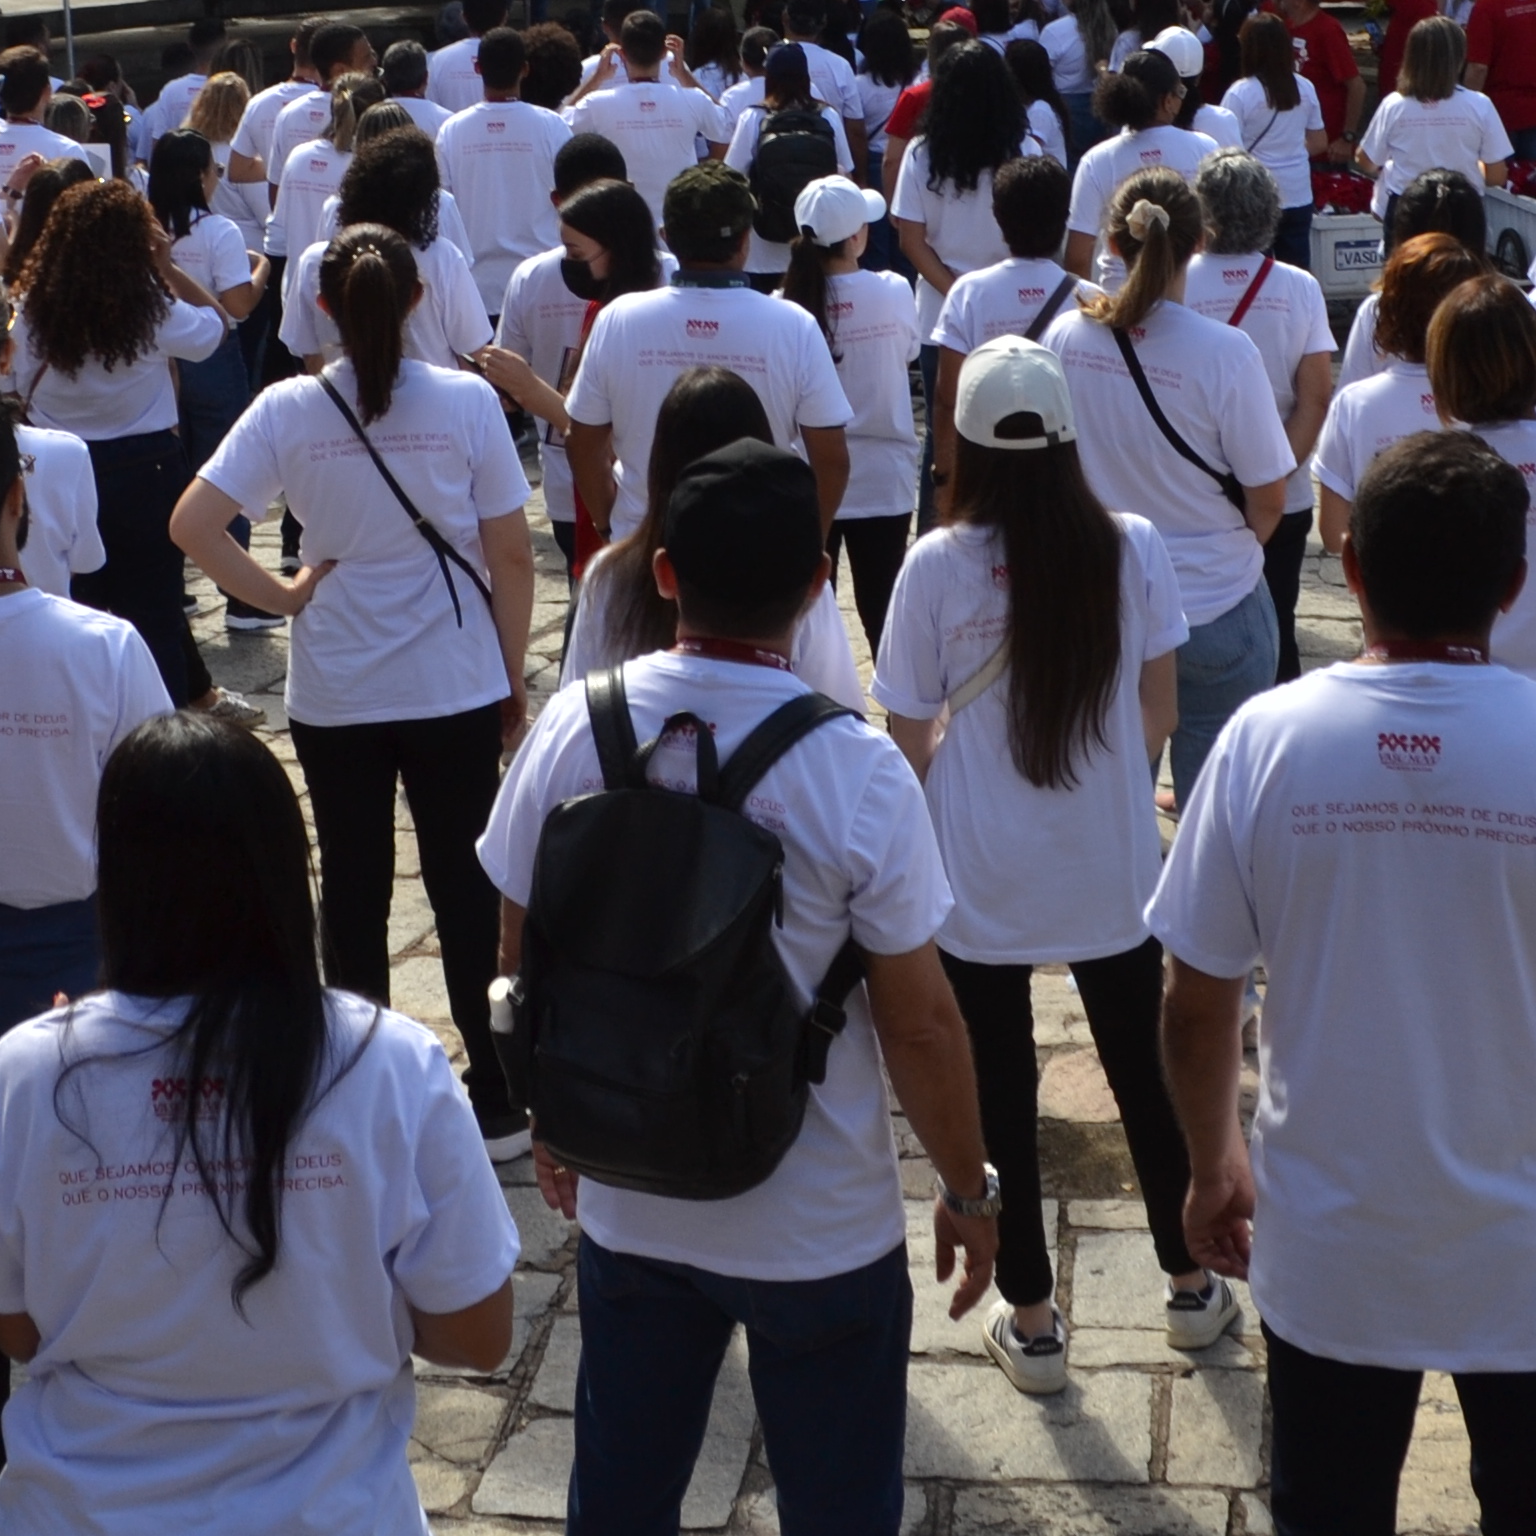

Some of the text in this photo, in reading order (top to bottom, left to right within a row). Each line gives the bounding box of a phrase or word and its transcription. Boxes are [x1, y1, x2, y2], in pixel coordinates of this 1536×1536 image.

[1344, 251, 1377, 266] VASO
[309, 441, 325, 451] QUE
[383, 433, 408, 442] AMOR
[411, 433, 423, 442] DE
[425, 433, 449, 442] DEUS
[14, 712, 30, 724] DE
[34, 713, 67, 725] DEUS
[749, 796, 786, 814] DEUS
[1291, 804, 1320, 819] QUE
[1325, 802, 1399, 816] SEJAMOS
[1404, 802, 1416, 814] O
[1422, 804, 1465, 819] AMOR
[1471, 807, 1492, 823] DE
[1291, 822, 1320, 837] QUE
[1325, 822, 1337, 834] O
[1343, 820, 1396, 834] NOSSO
[1401, 817, 1469, 838] PRÓXIMO
[58, 1169, 90, 1185] QUE
[95, 1161, 178, 1181] SEJAMOS
[295, 1153, 342, 1172] DEUS
[62, 1189, 91, 1206] QUE
[97, 1187, 110, 1202] O
[114, 1183, 175, 1200] NOSSO
